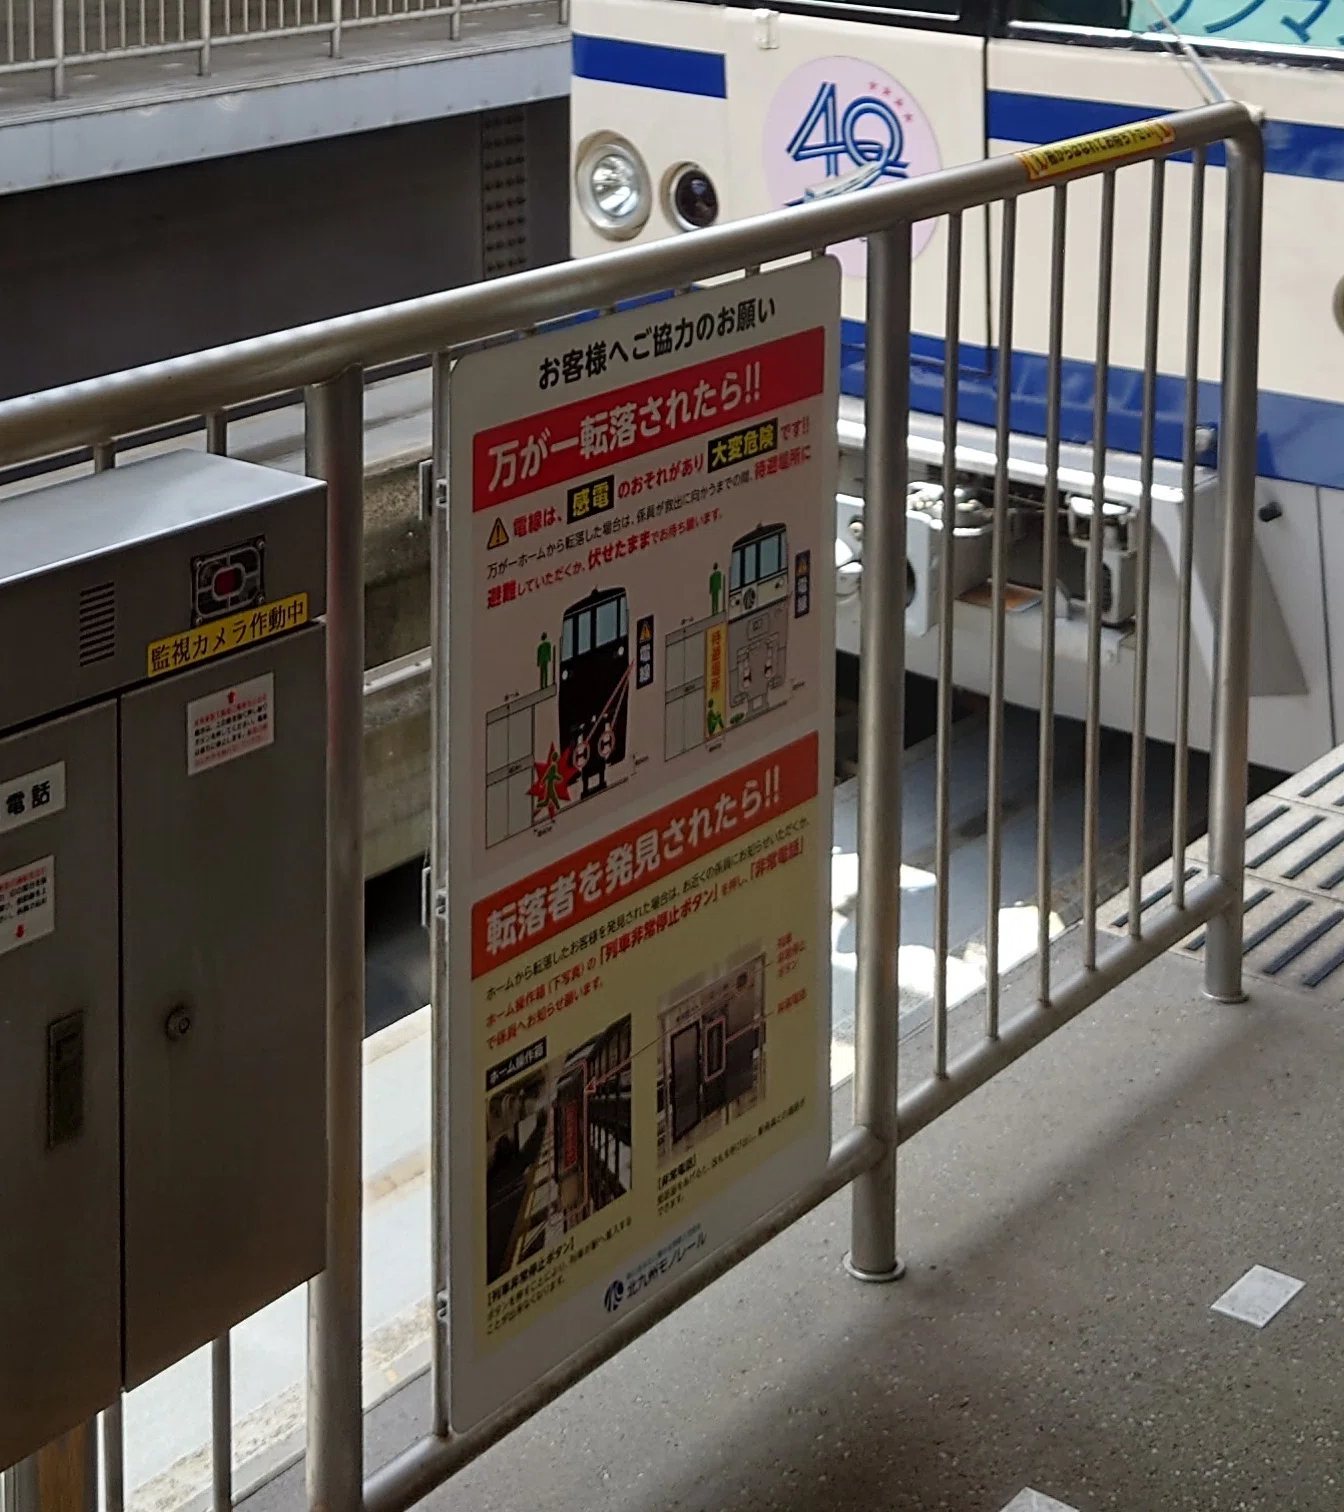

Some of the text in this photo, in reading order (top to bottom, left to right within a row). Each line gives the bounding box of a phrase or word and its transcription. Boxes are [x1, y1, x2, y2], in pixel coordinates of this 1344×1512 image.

[539, 297, 775, 390] お客様へご協力のお願い
[572, 480, 609, 518] 感電
[711, 422, 773, 468] 大変危険
[151, 600, 304, 672] 監視カメラ作動中
